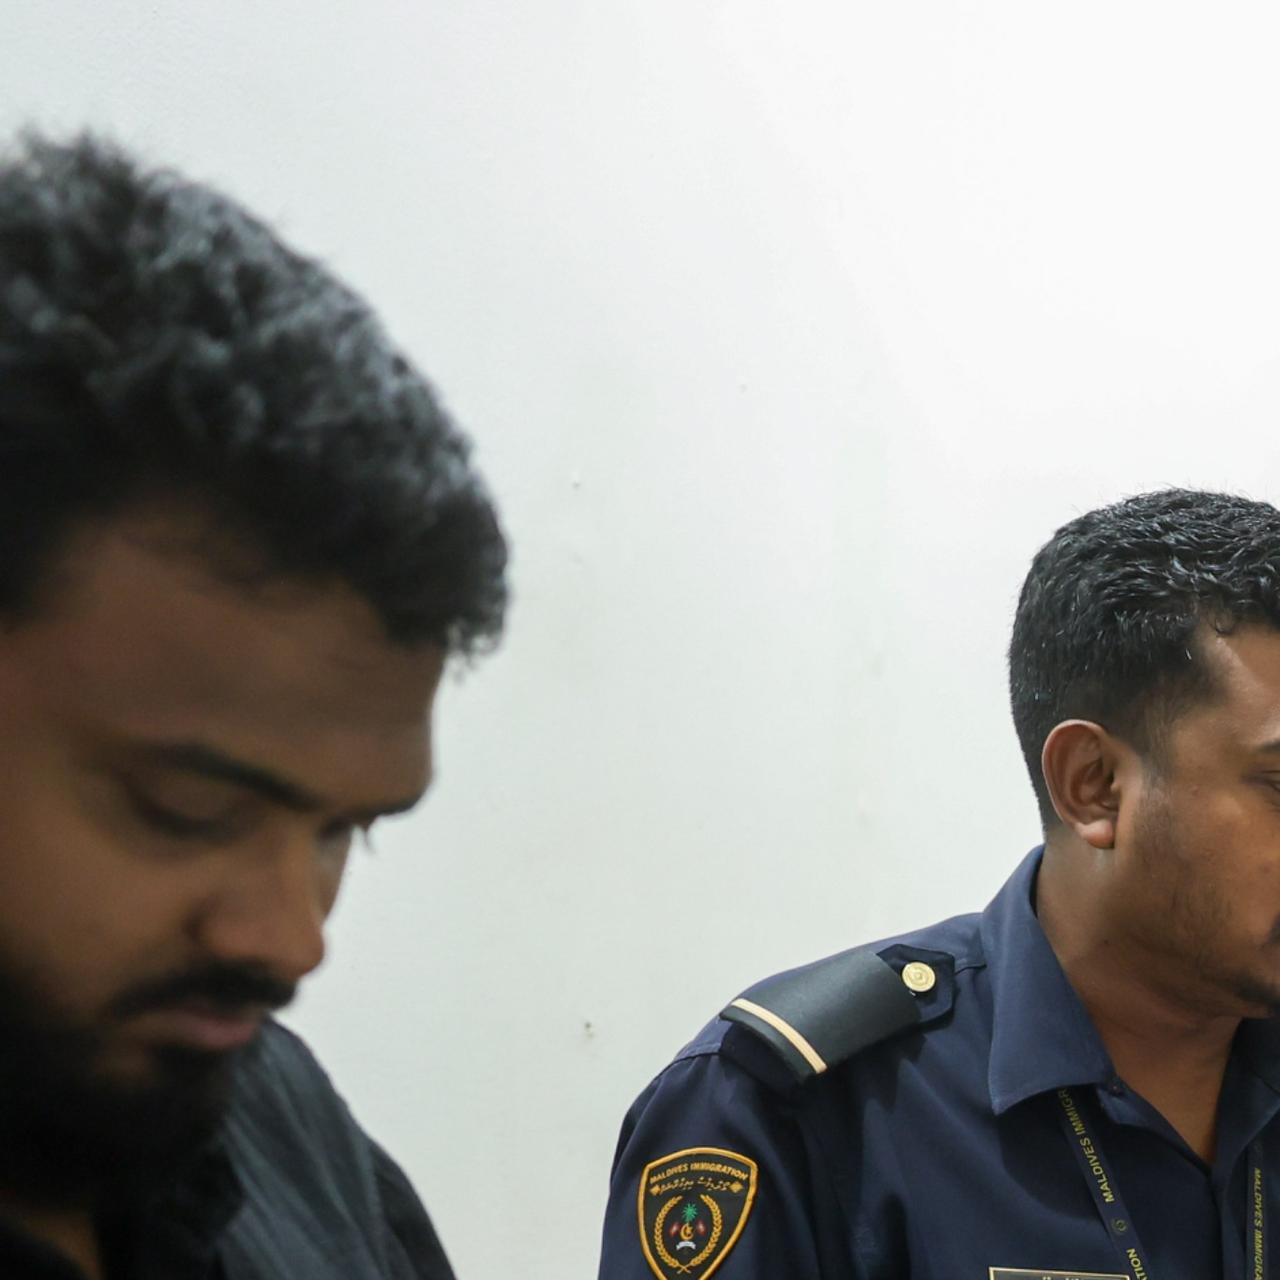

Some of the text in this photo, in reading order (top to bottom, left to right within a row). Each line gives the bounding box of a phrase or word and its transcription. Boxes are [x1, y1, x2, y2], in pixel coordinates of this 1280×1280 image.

[649, 1162, 749, 1184] MALDIVES IMMIGRATION
[1079, 1138, 1115, 1203] MALDIVES
[1252, 1168, 1262, 1227] MALDIVES
